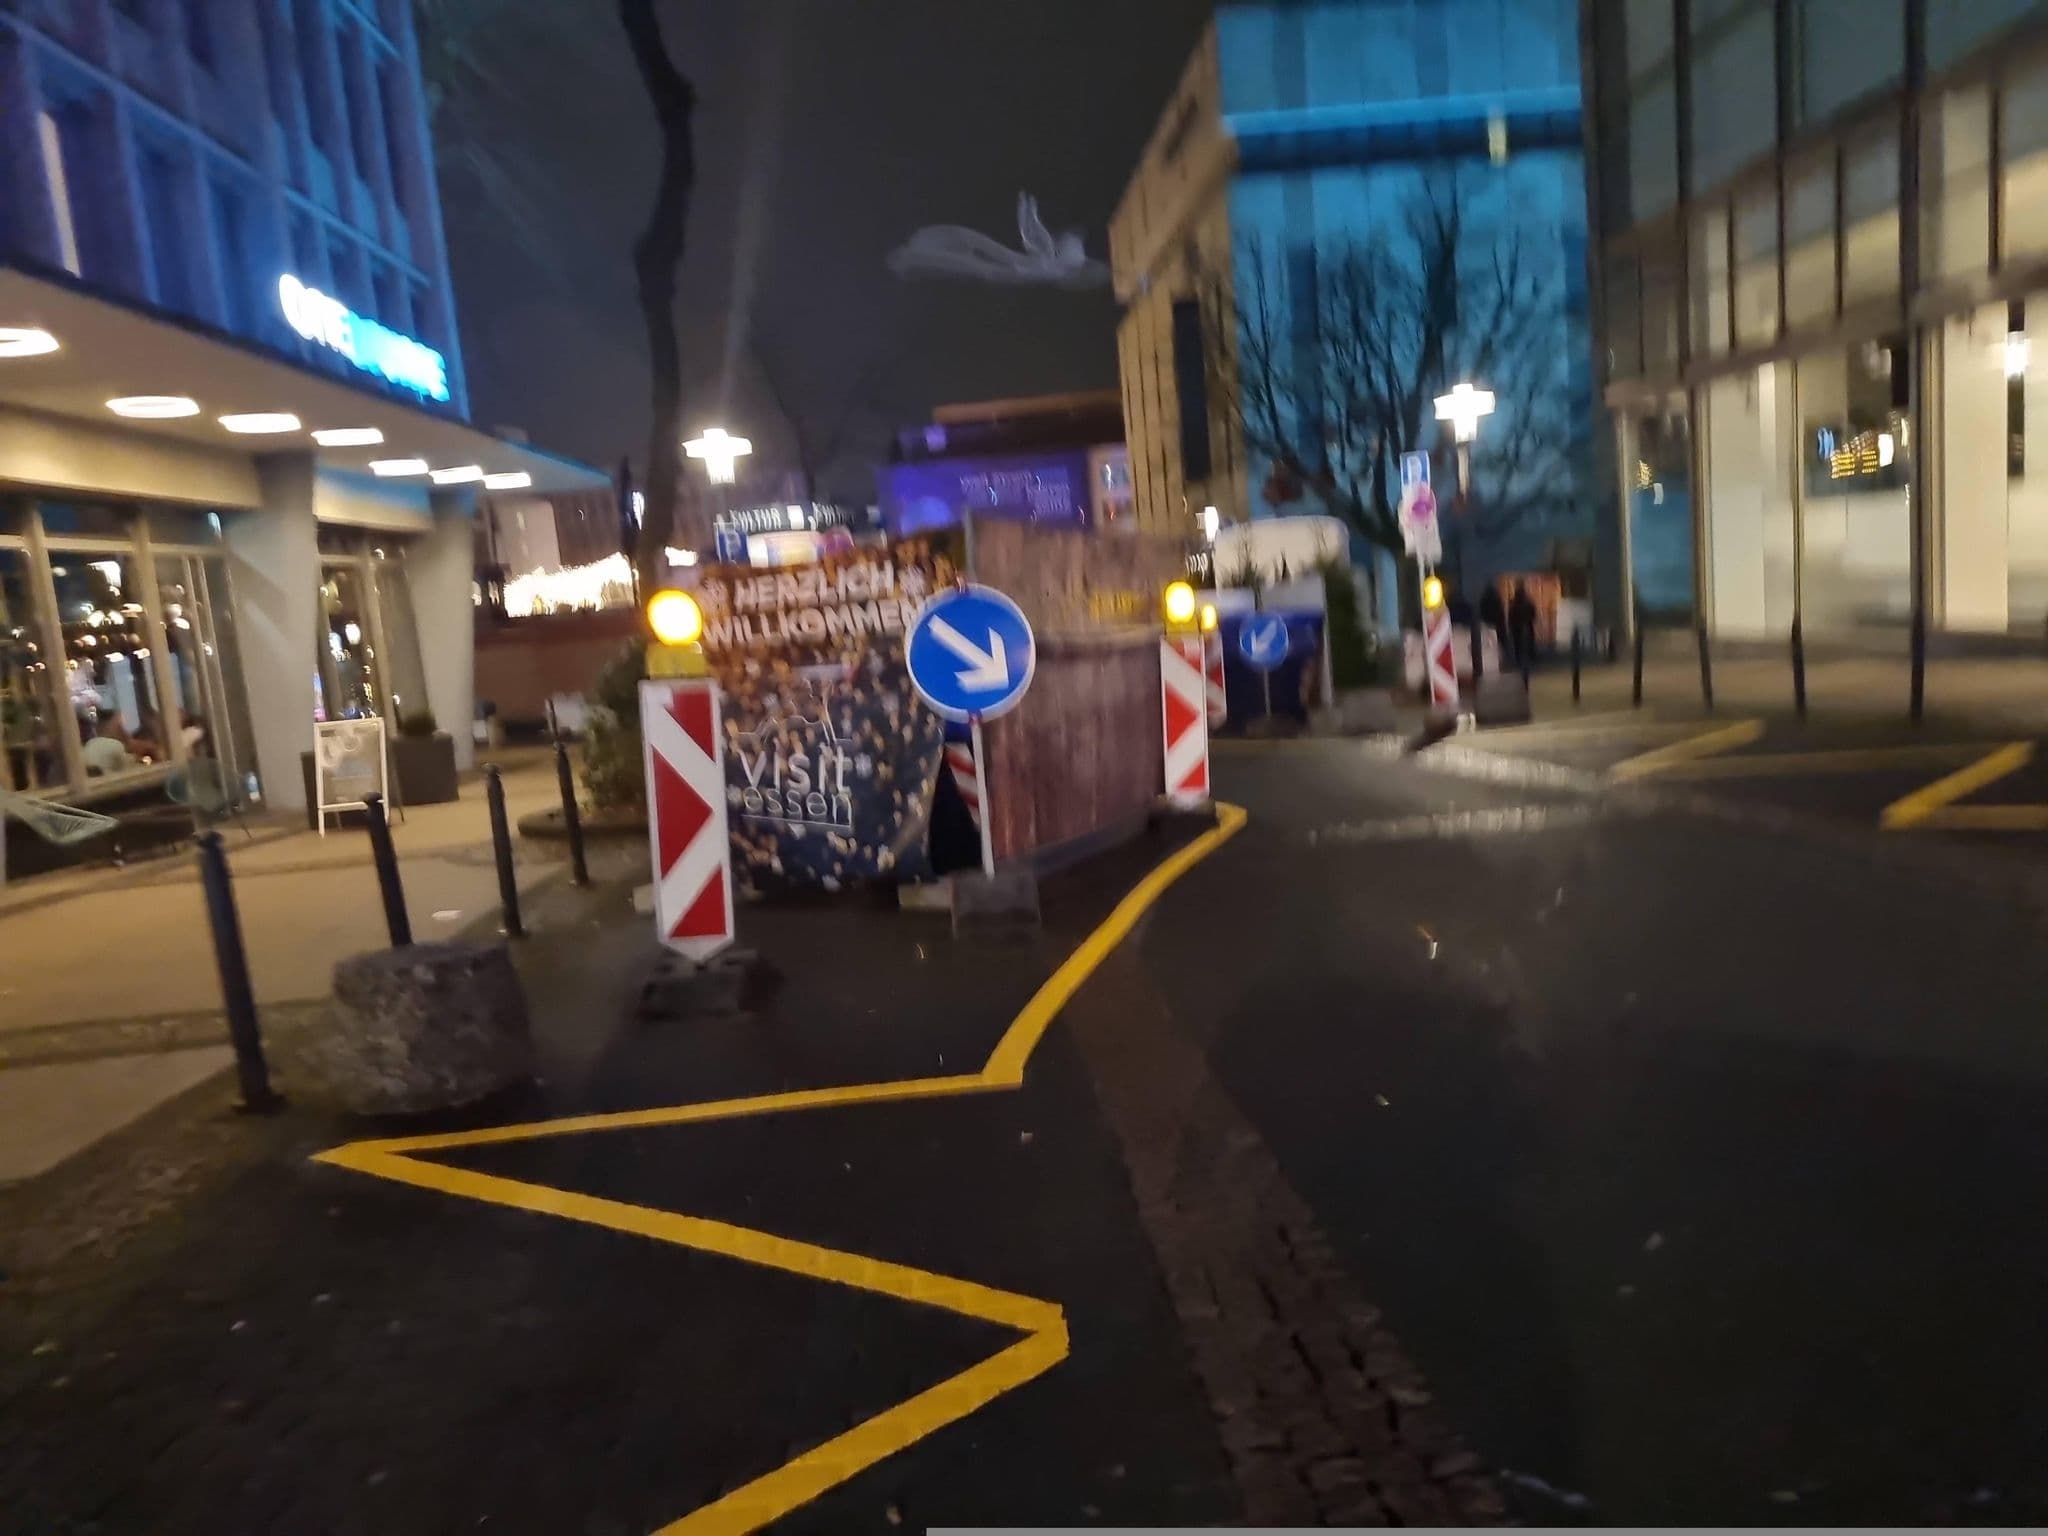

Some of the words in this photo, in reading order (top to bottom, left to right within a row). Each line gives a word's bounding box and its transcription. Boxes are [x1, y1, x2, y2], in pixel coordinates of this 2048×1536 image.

[734, 559, 895, 615] HERZLICH
[738, 741, 854, 798] VISIT
[742, 786, 853, 825] essen
